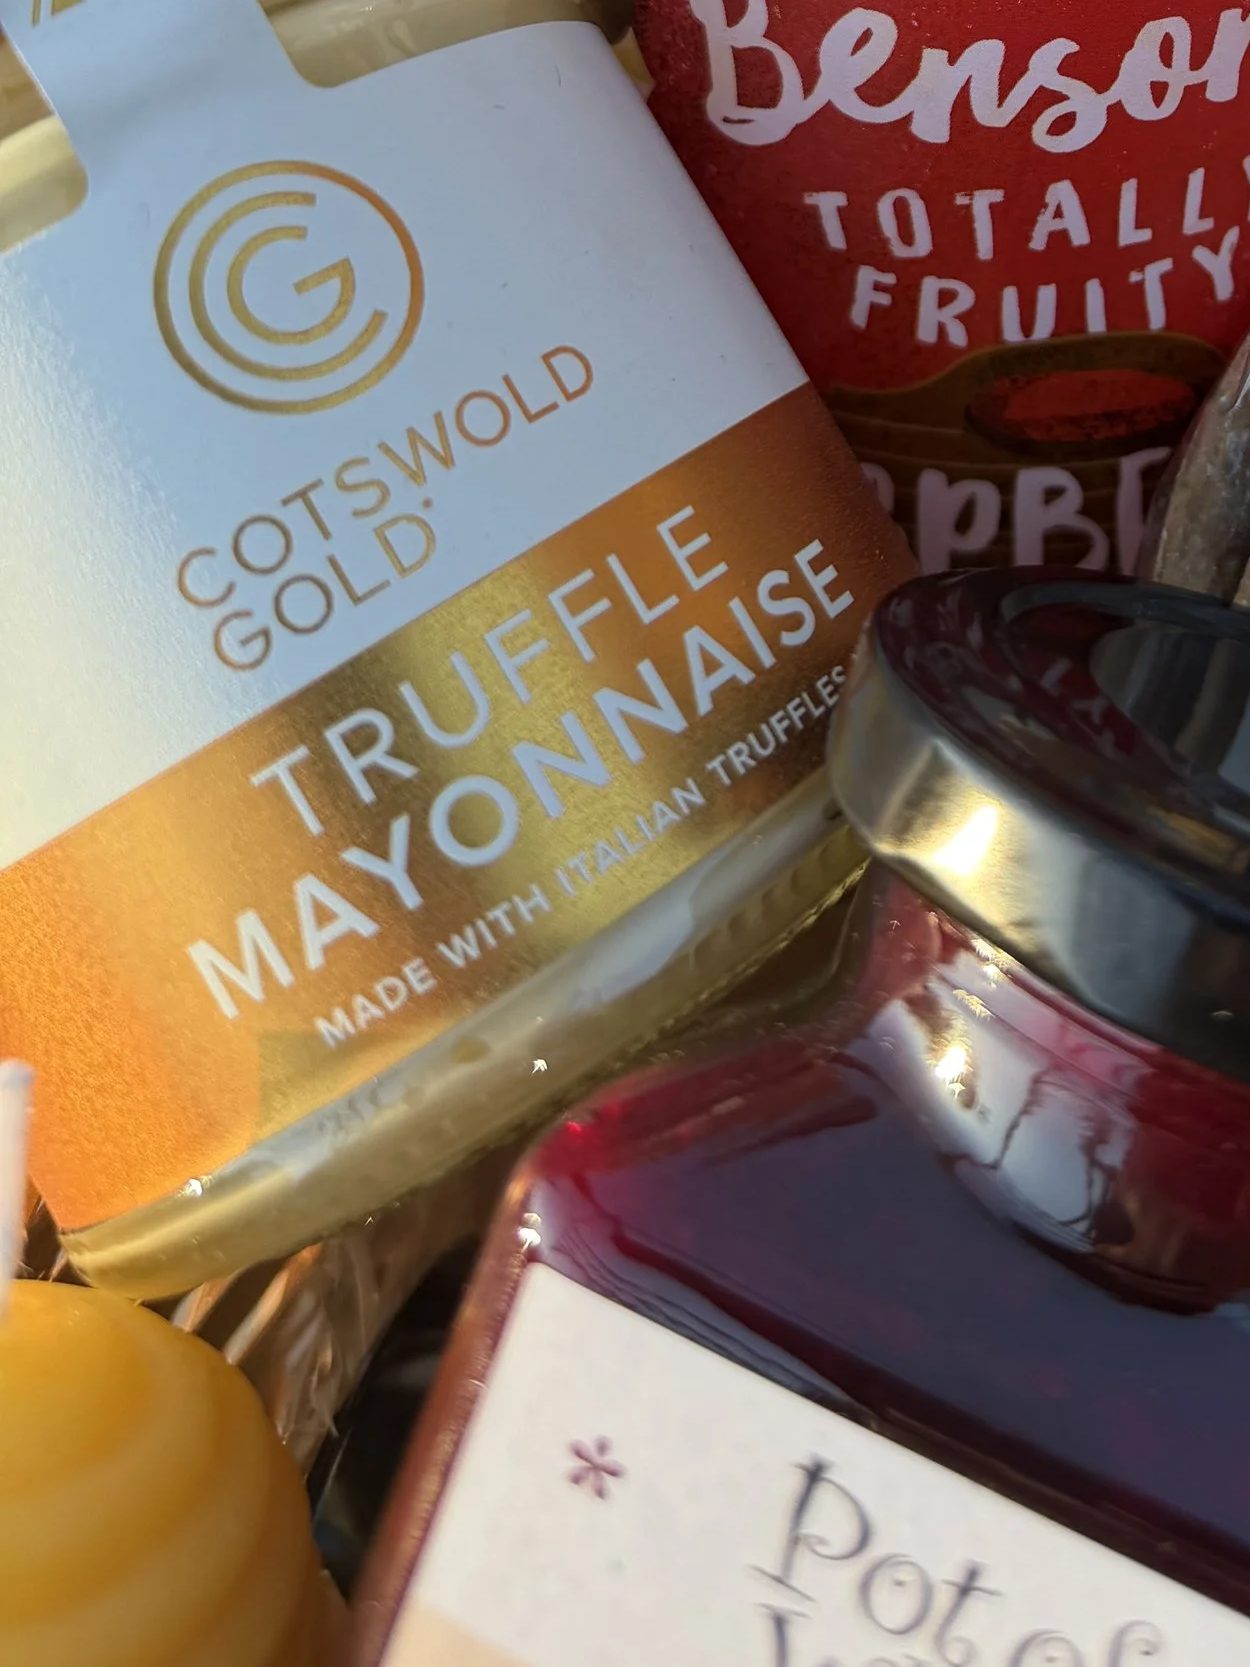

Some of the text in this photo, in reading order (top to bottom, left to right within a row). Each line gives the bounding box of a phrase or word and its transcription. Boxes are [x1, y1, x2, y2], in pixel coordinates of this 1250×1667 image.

[851, 226, 1241, 347] FRUITY
[177, 345, 595, 610] COTSWOLD
[213, 513, 437, 671] GOLD
[187, 539, 856, 1021] MAYONNAISE
[250, 504, 729, 839] TRUFFLE
[314, 665, 847, 1048] MADE WITH ITALIAN TRUFFLES
[749, 1452, 1003, 1666] Pot
